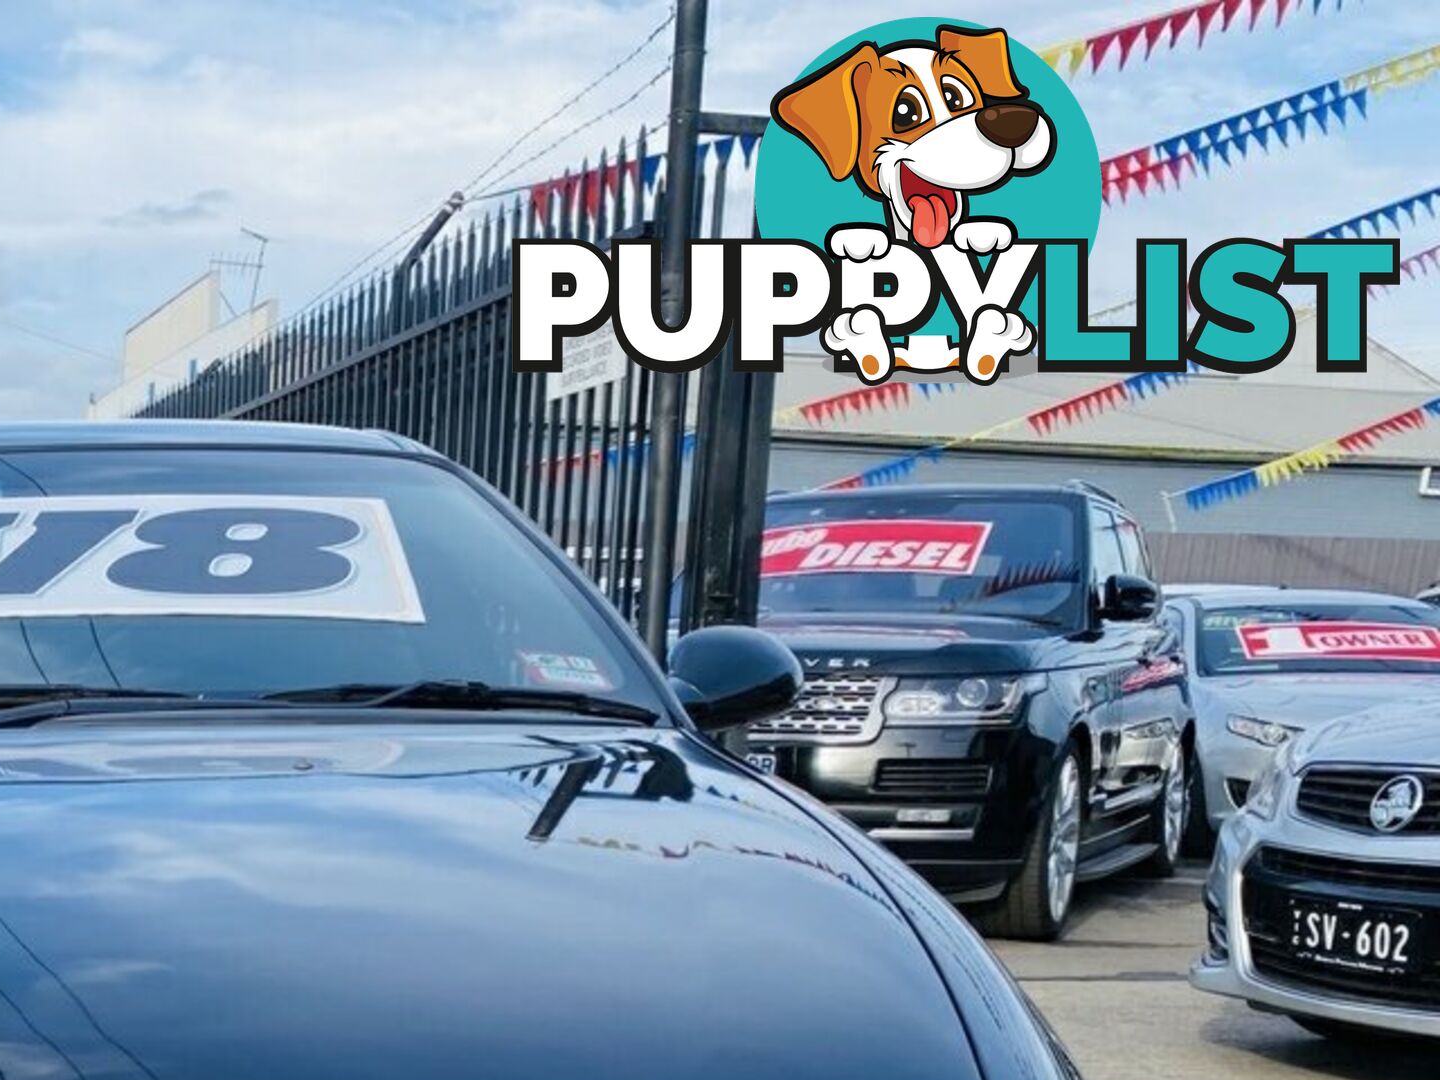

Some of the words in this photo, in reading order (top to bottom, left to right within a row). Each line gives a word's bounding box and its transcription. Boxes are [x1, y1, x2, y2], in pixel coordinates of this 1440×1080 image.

[798, 541, 973, 569] DIESEL
[1246, 626, 1318, 657] 1
[1319, 633, 1425, 649] OWNER
